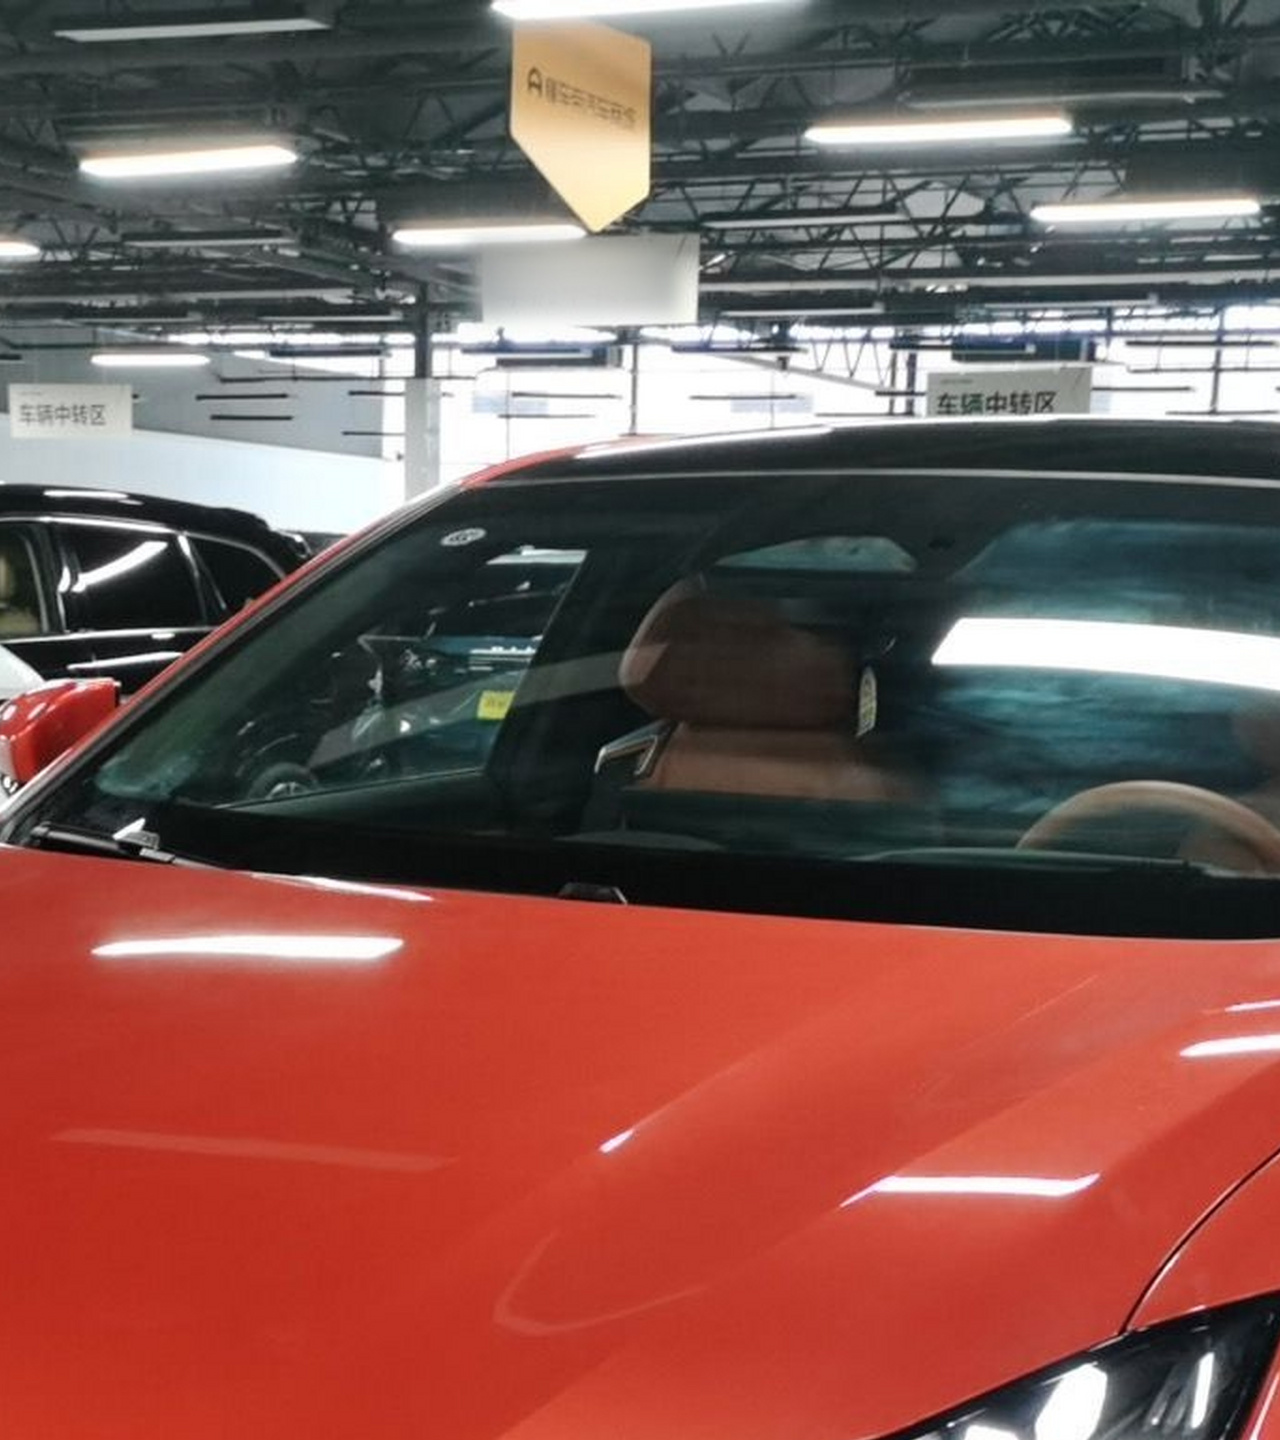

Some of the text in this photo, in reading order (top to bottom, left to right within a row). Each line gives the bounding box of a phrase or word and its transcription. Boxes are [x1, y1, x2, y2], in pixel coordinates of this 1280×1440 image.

[936, 390, 1058, 415] 车辆中转区
